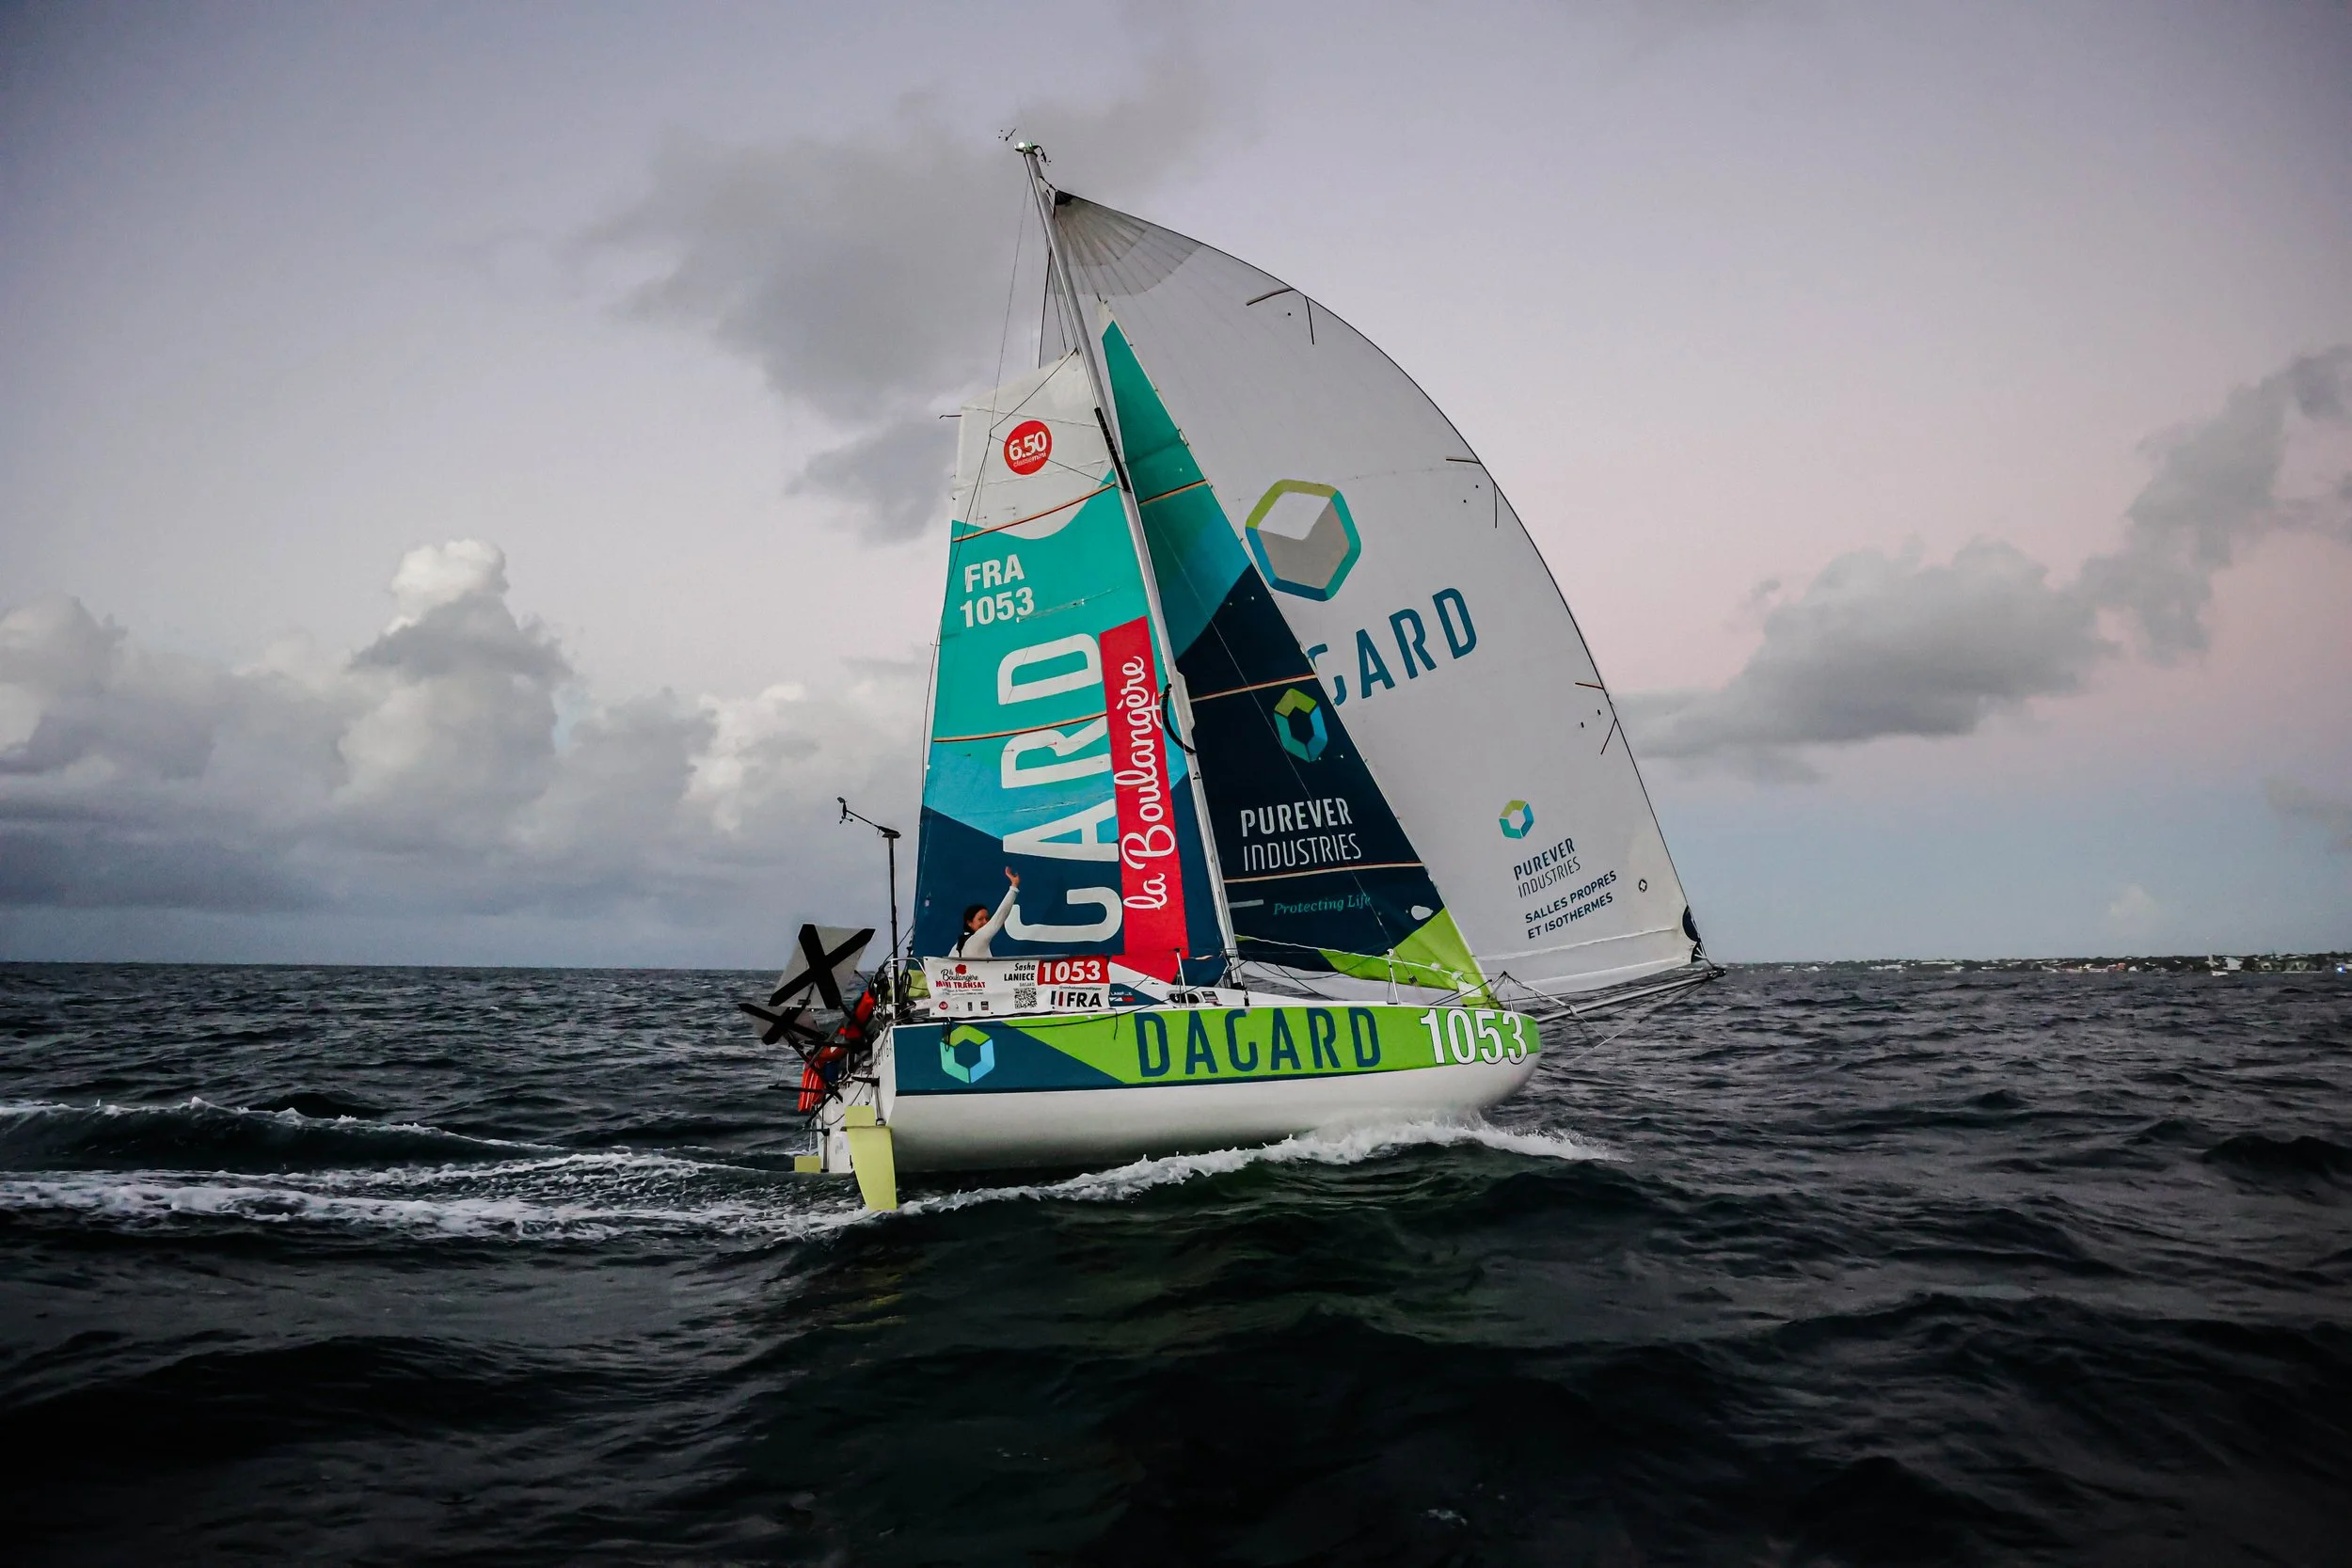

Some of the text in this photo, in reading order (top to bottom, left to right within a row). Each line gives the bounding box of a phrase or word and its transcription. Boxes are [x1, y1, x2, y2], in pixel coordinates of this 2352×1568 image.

[1009, 431, 1047, 461] 6.50
[964, 554, 1025, 593] FRA
[960, 586, 1034, 627] 1053
[1114, 656, 1175, 910] la Boulangère
[1240, 798, 1353, 837] PUREVER
[1243, 832, 1362, 871] INDUSTRIES
[1513, 837, 1575, 880] PUREVER
[1518, 856, 1581, 898] INDUSTRIES
[1273, 894, 1371, 915] Protecting Life
[1525, 870, 1617, 924] SALLES PROPRES
[1527, 892, 1613, 940] ET ISOTHERMES
[1004, 973, 1035, 981] LANIECE
[1014, 962, 1036, 972] Sasha
[1042, 960, 1101, 982] 1053
[1066, 991, 1102, 1007] FRA
[1134, 1006, 1382, 1077] DAGARD
[1420, 1008, 1529, 1064] 1053
